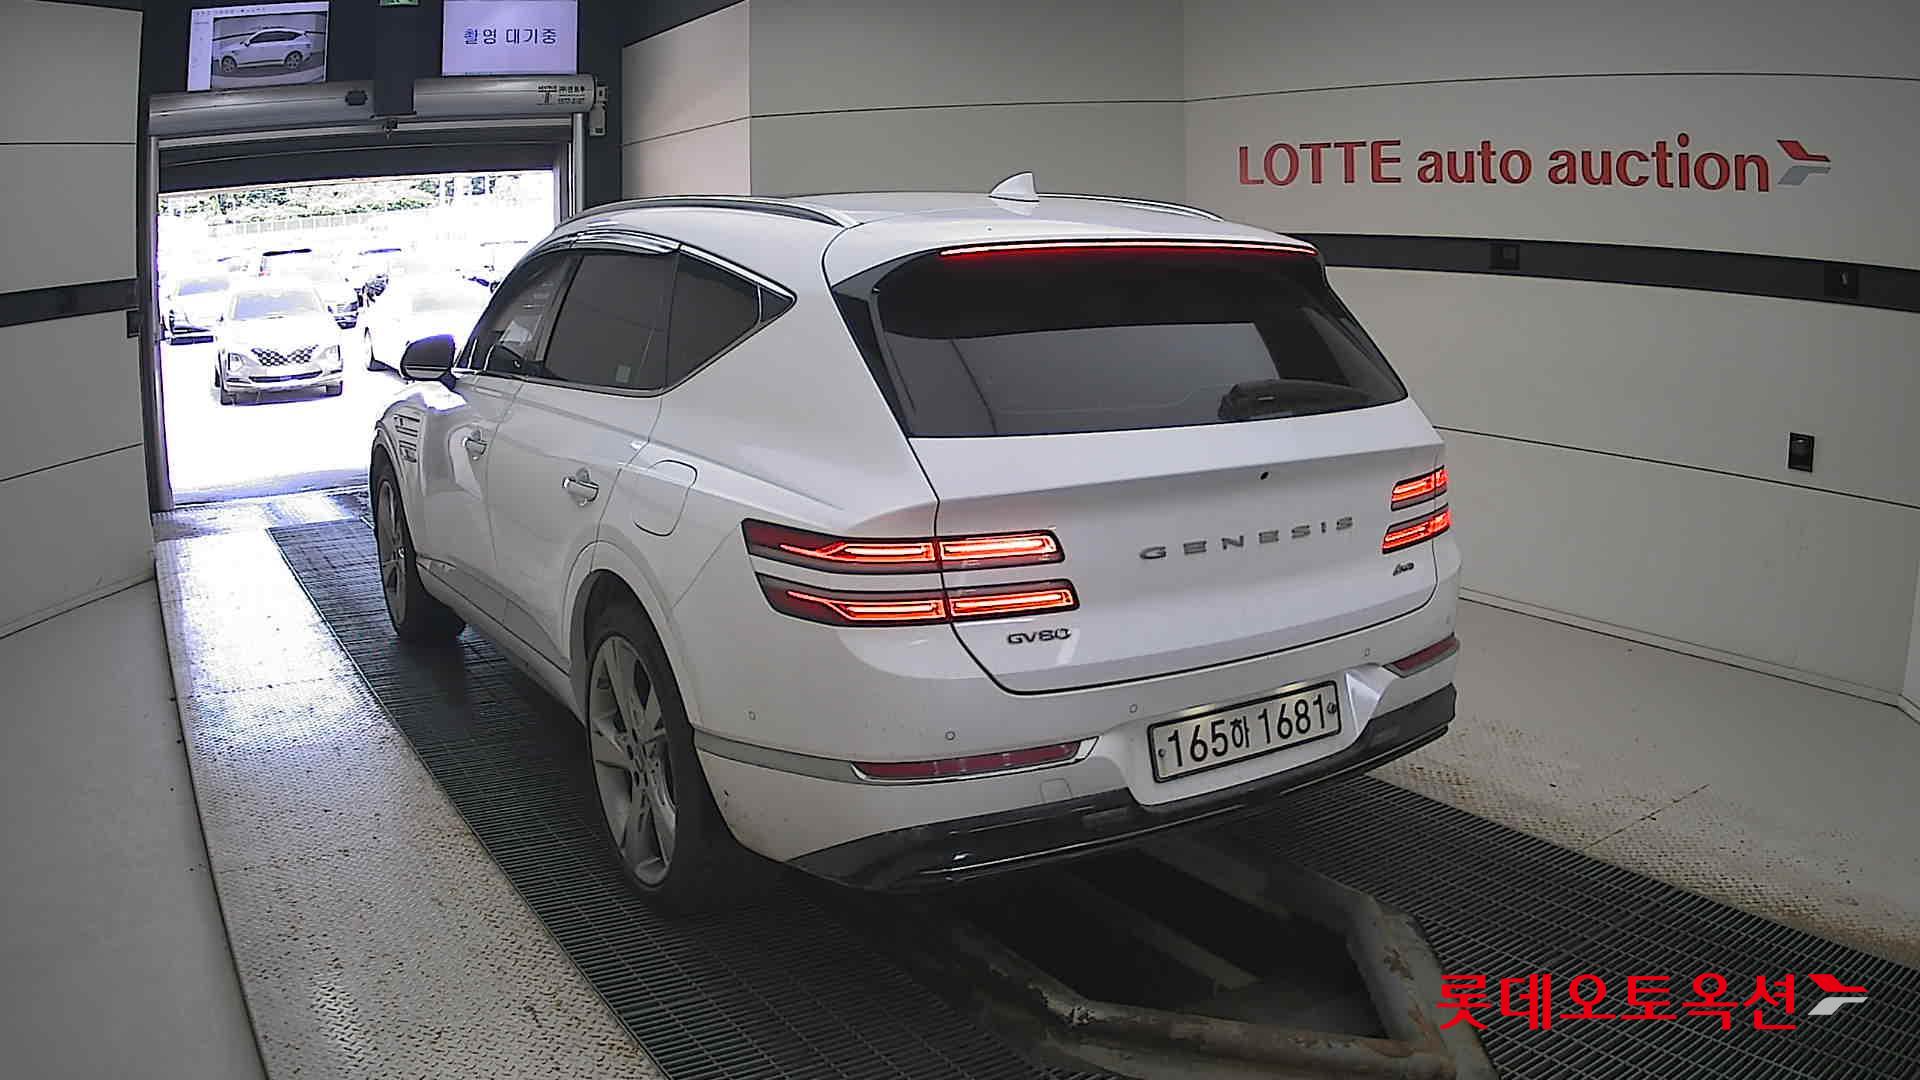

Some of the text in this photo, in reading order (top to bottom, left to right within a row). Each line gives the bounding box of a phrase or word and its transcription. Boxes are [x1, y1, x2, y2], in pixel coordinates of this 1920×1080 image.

[505, 28, 557, 45] 대기중
[1239, 132, 1769, 192] LOTTE auto auction
[1140, 516, 1353, 560] GENESIS
[1007, 628, 1072, 644] GV80
[1168, 694, 1326, 767] 165하 1681
